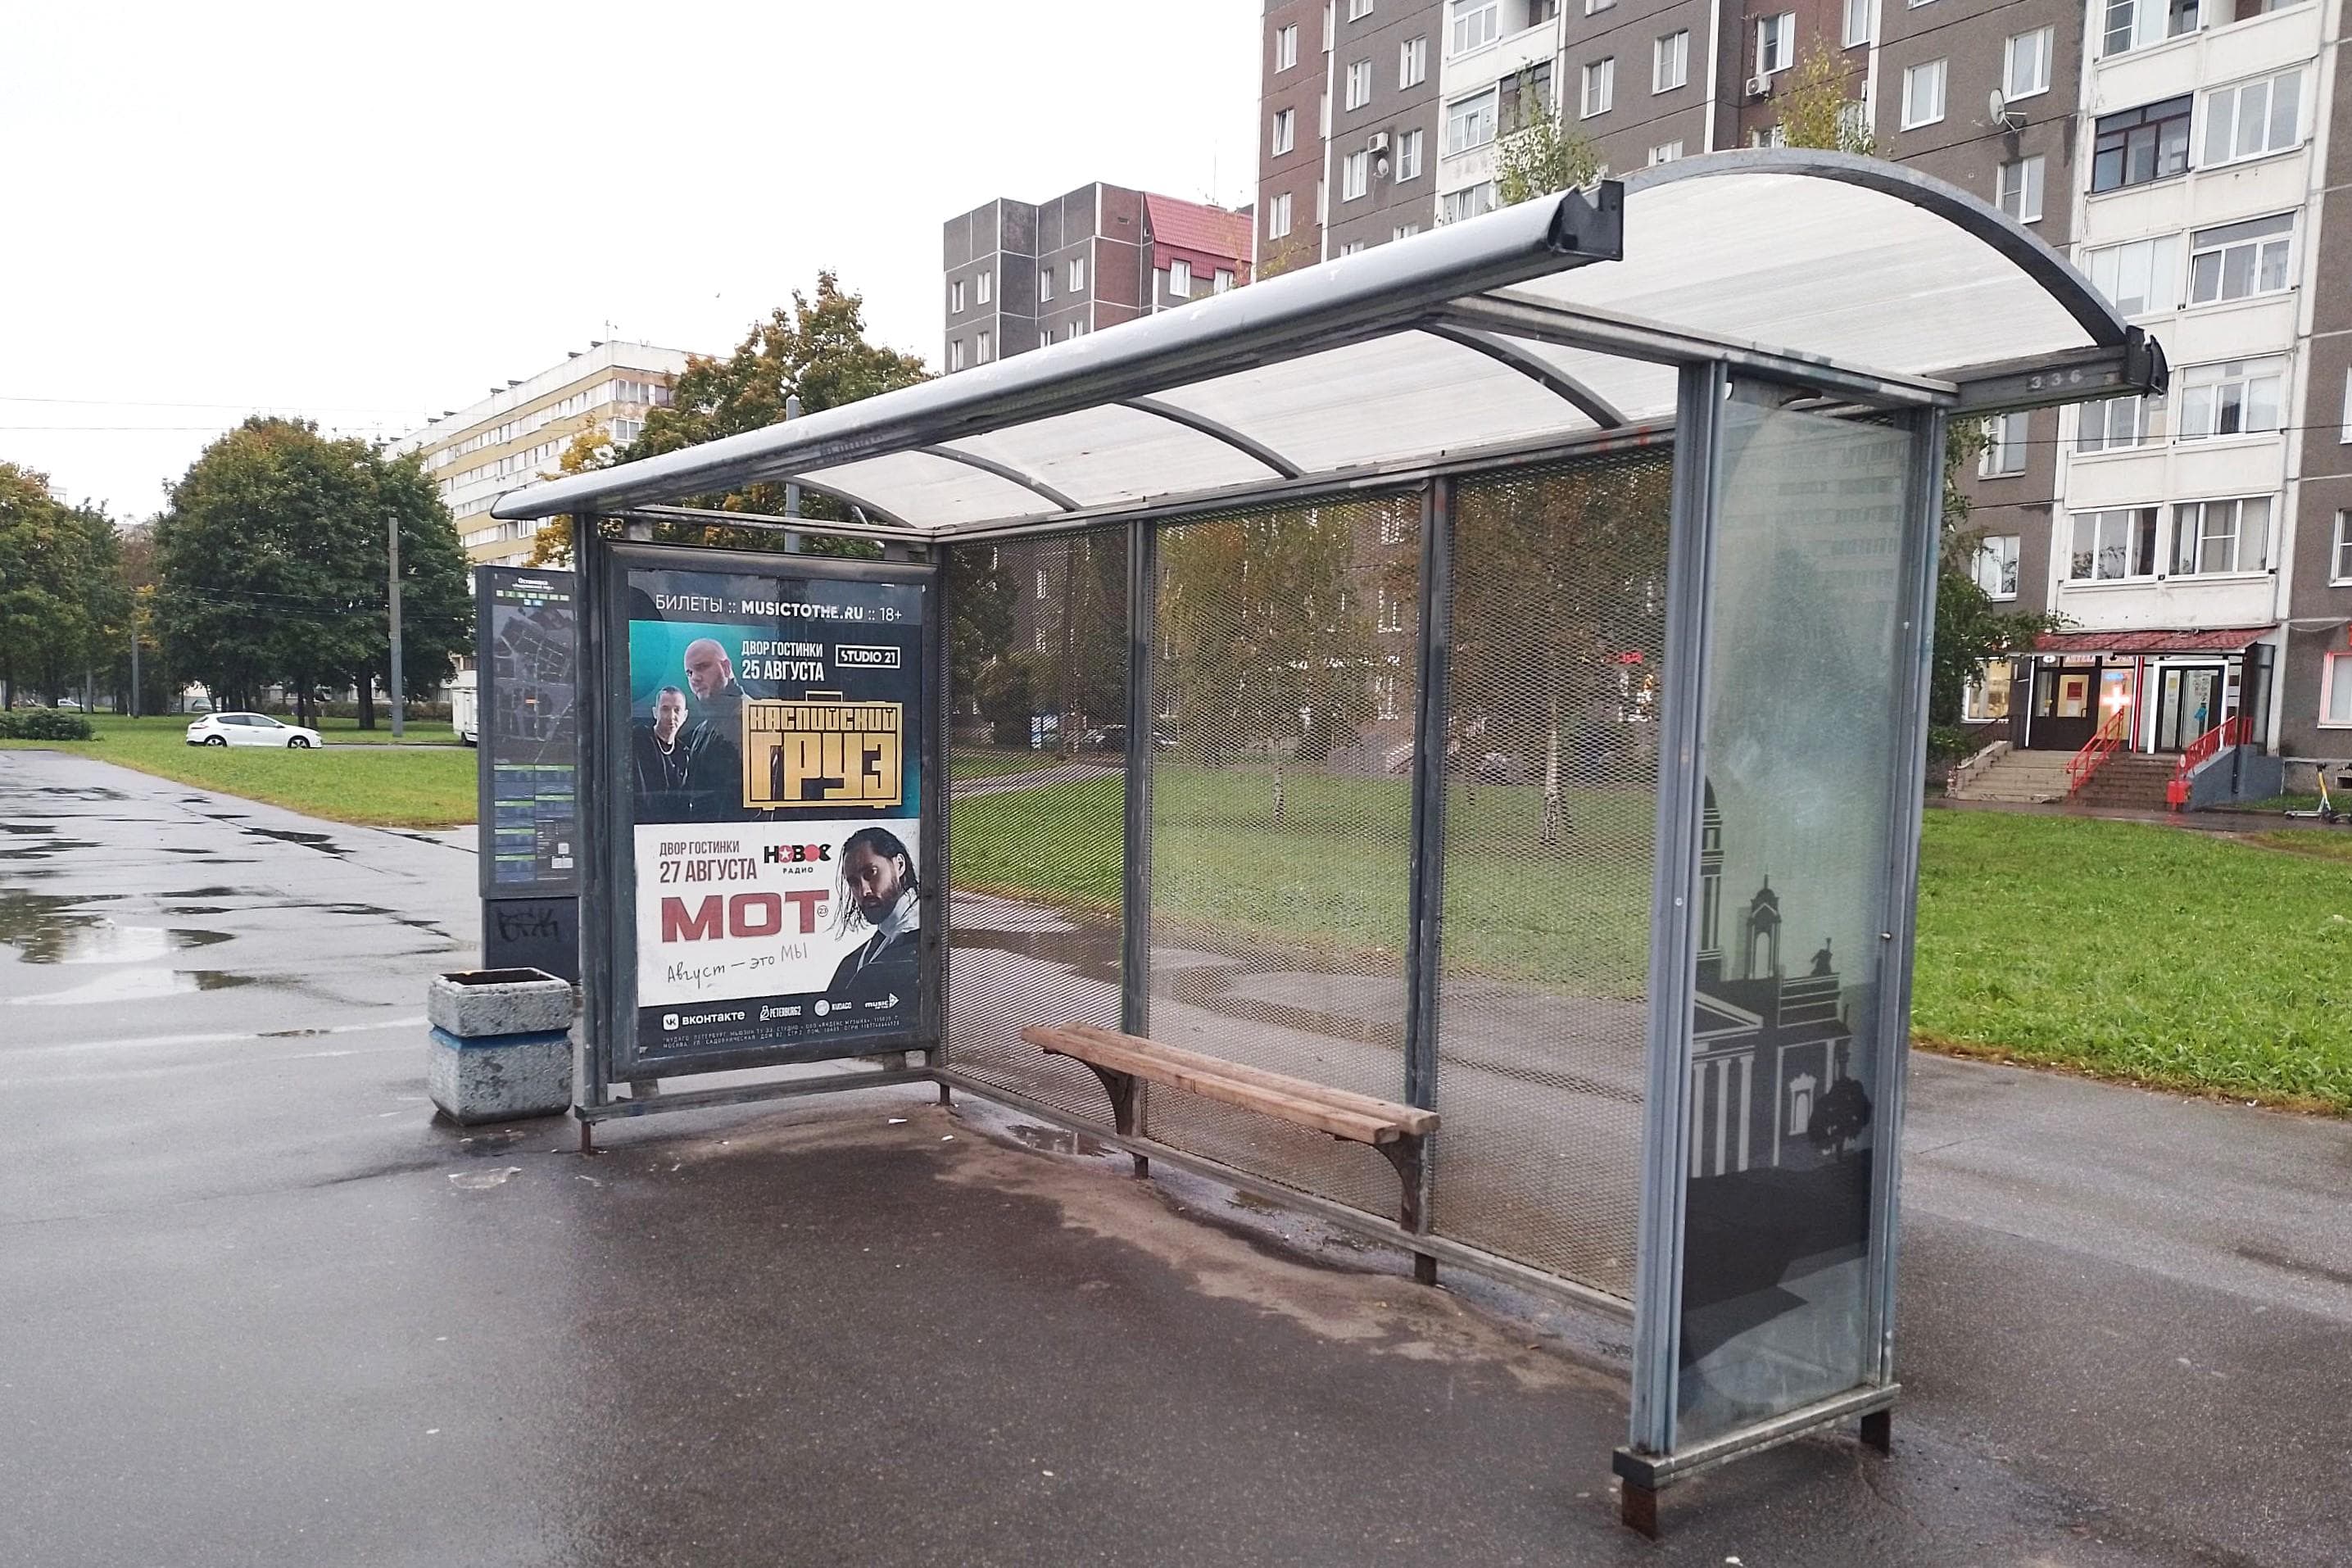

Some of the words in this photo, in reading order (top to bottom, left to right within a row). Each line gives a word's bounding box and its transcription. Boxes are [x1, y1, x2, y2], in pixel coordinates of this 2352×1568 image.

[656, 595, 723, 612] БИЛЕТЫ
[741, 600, 863, 619] MUSICTOTHE.RU
[880, 607, 902, 622] 18+
[741, 640, 769, 656] ДВОР
[772, 641, 823, 658] ГОСТИНКИ
[841, 650, 881, 664] STUDIO
[884, 651, 895, 664] 21
[742, 659, 759, 679] 25
[764, 659, 825, 682] АВГУСТА
[750, 706, 896, 731] КАСПИЙСКИЙ
[750, 732, 896, 800] ГРУЗ
[659, 841, 687, 857] ДВОР
[689, 841, 739, 854] ГОСТИНКИ
[659, 861, 680, 883] 27
[685, 858, 758, 882] АВГУСТА
[661, 890, 829, 943] МОТ
[668, 962, 726, 989] Август
[750, 955, 774, 969] это
[781, 942, 808, 963] МЫ
